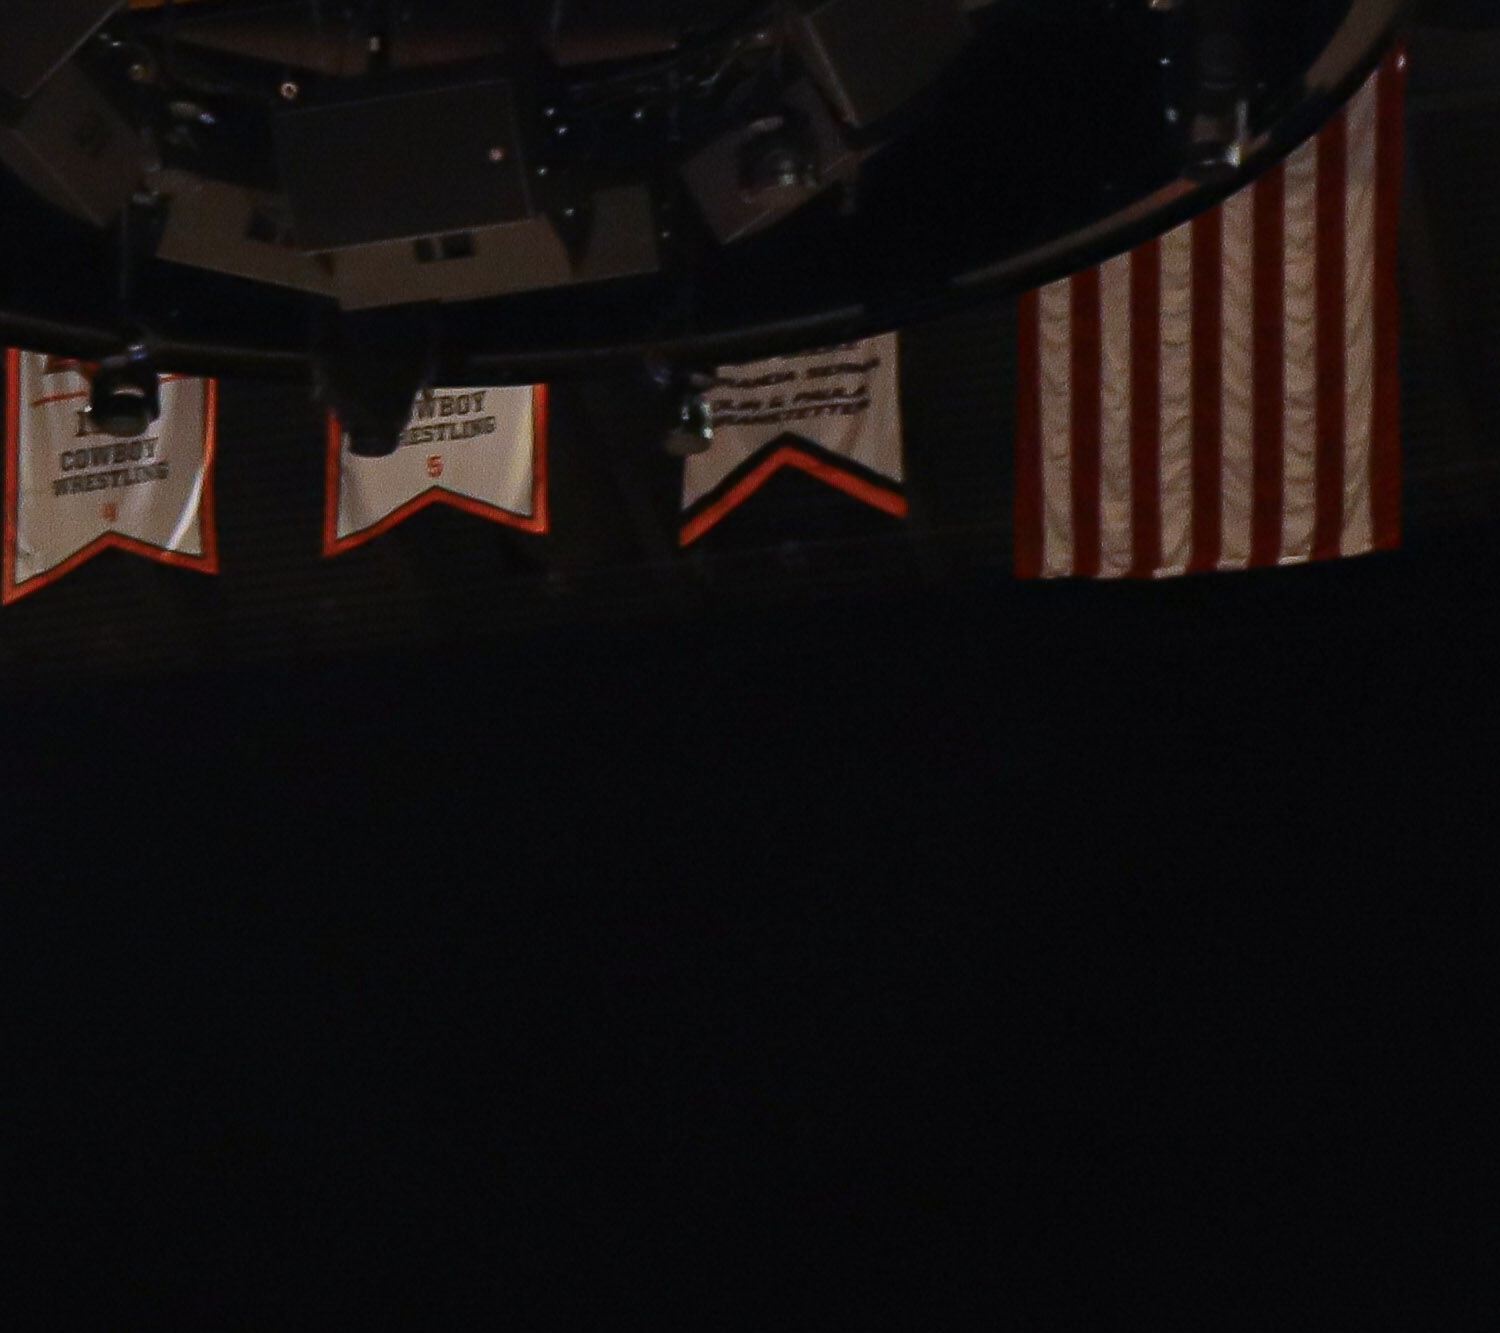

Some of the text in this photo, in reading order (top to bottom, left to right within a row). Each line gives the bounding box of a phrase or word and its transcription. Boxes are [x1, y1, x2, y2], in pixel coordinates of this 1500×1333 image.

[61, 437, 159, 471] COWBOY
[427, 454, 444, 478] 5
[54, 462, 169, 496] WRESTLING
